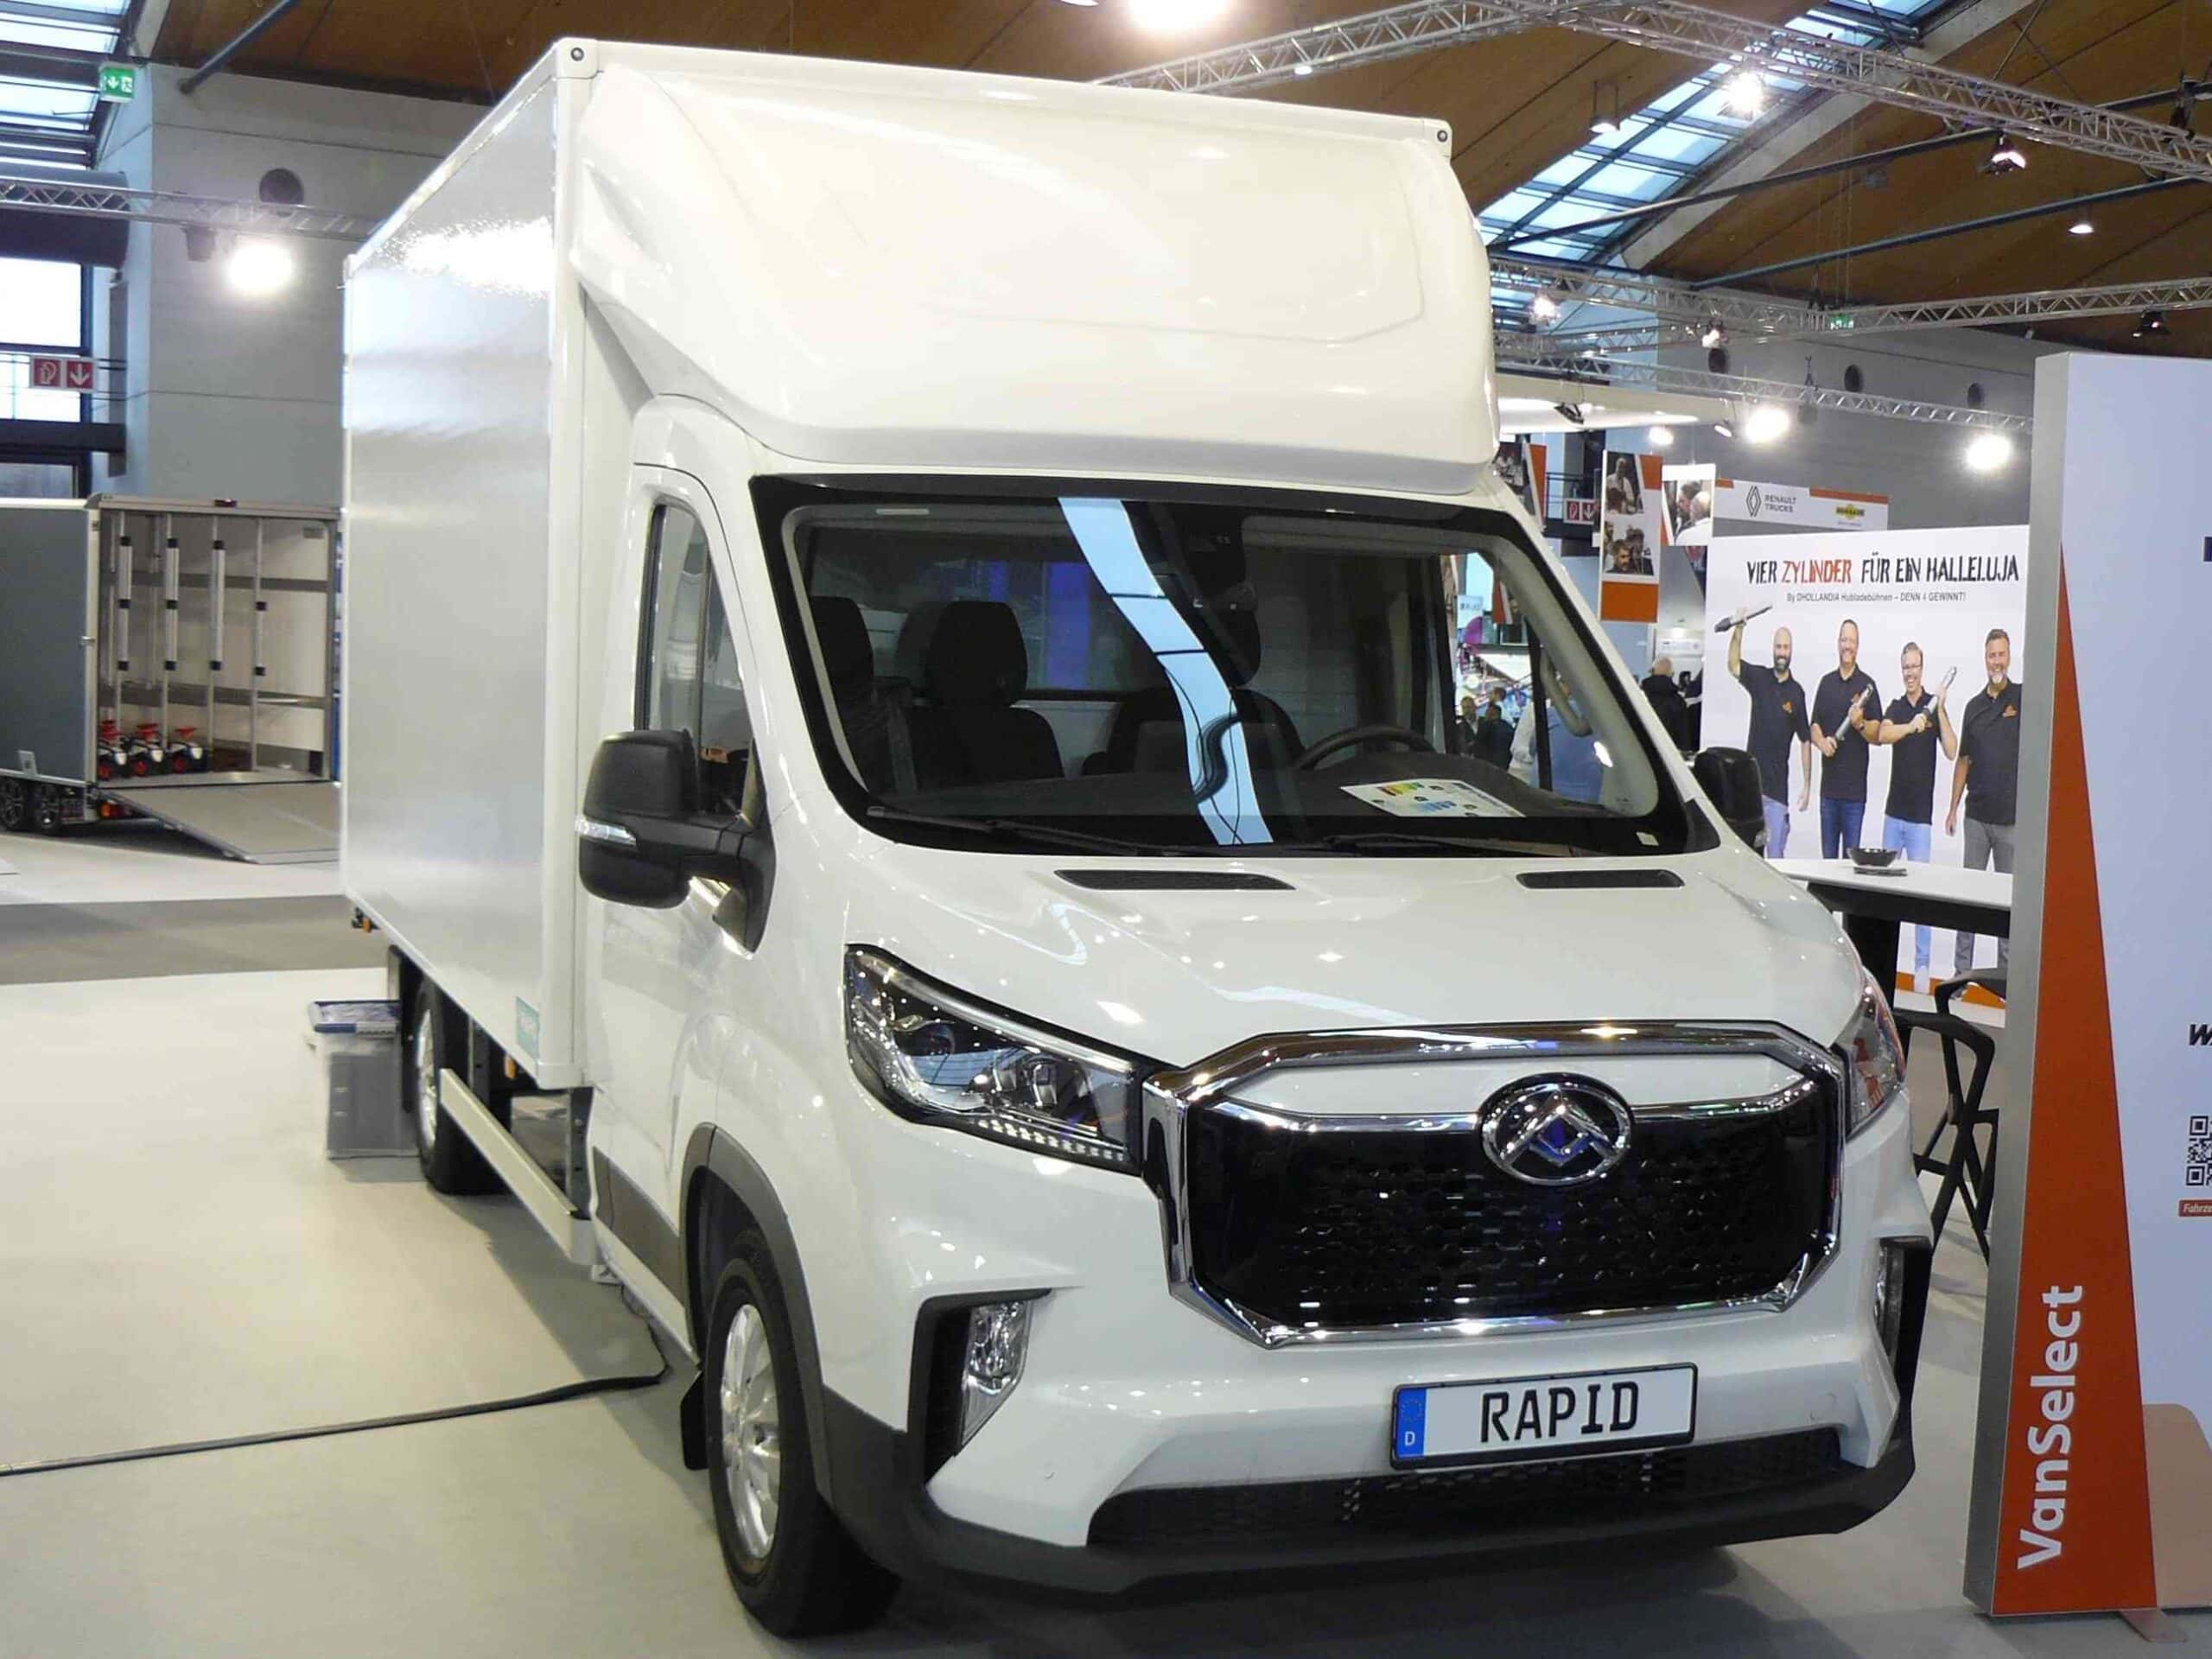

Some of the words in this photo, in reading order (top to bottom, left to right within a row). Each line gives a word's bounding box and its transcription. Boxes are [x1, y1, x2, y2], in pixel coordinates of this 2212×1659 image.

[1765, 495, 1796, 505] RENAULT
[1765, 504, 1794, 512] TRUCKS
[1746, 560, 1777, 584] VIER
[1781, 559, 1853, 584] ZYLINDER
[1861, 552, 1891, 583] FÜR
[1895, 556, 1922, 583] EIN
[1926, 555, 2019, 582] HALLELUJA
[1900, 592, 1921, 601] DENN
[1480, 1381, 1640, 1443] RAPID
[2017, 1285, 2083, 1570] VanSelect
[1404, 1431, 1416, 1446] D
